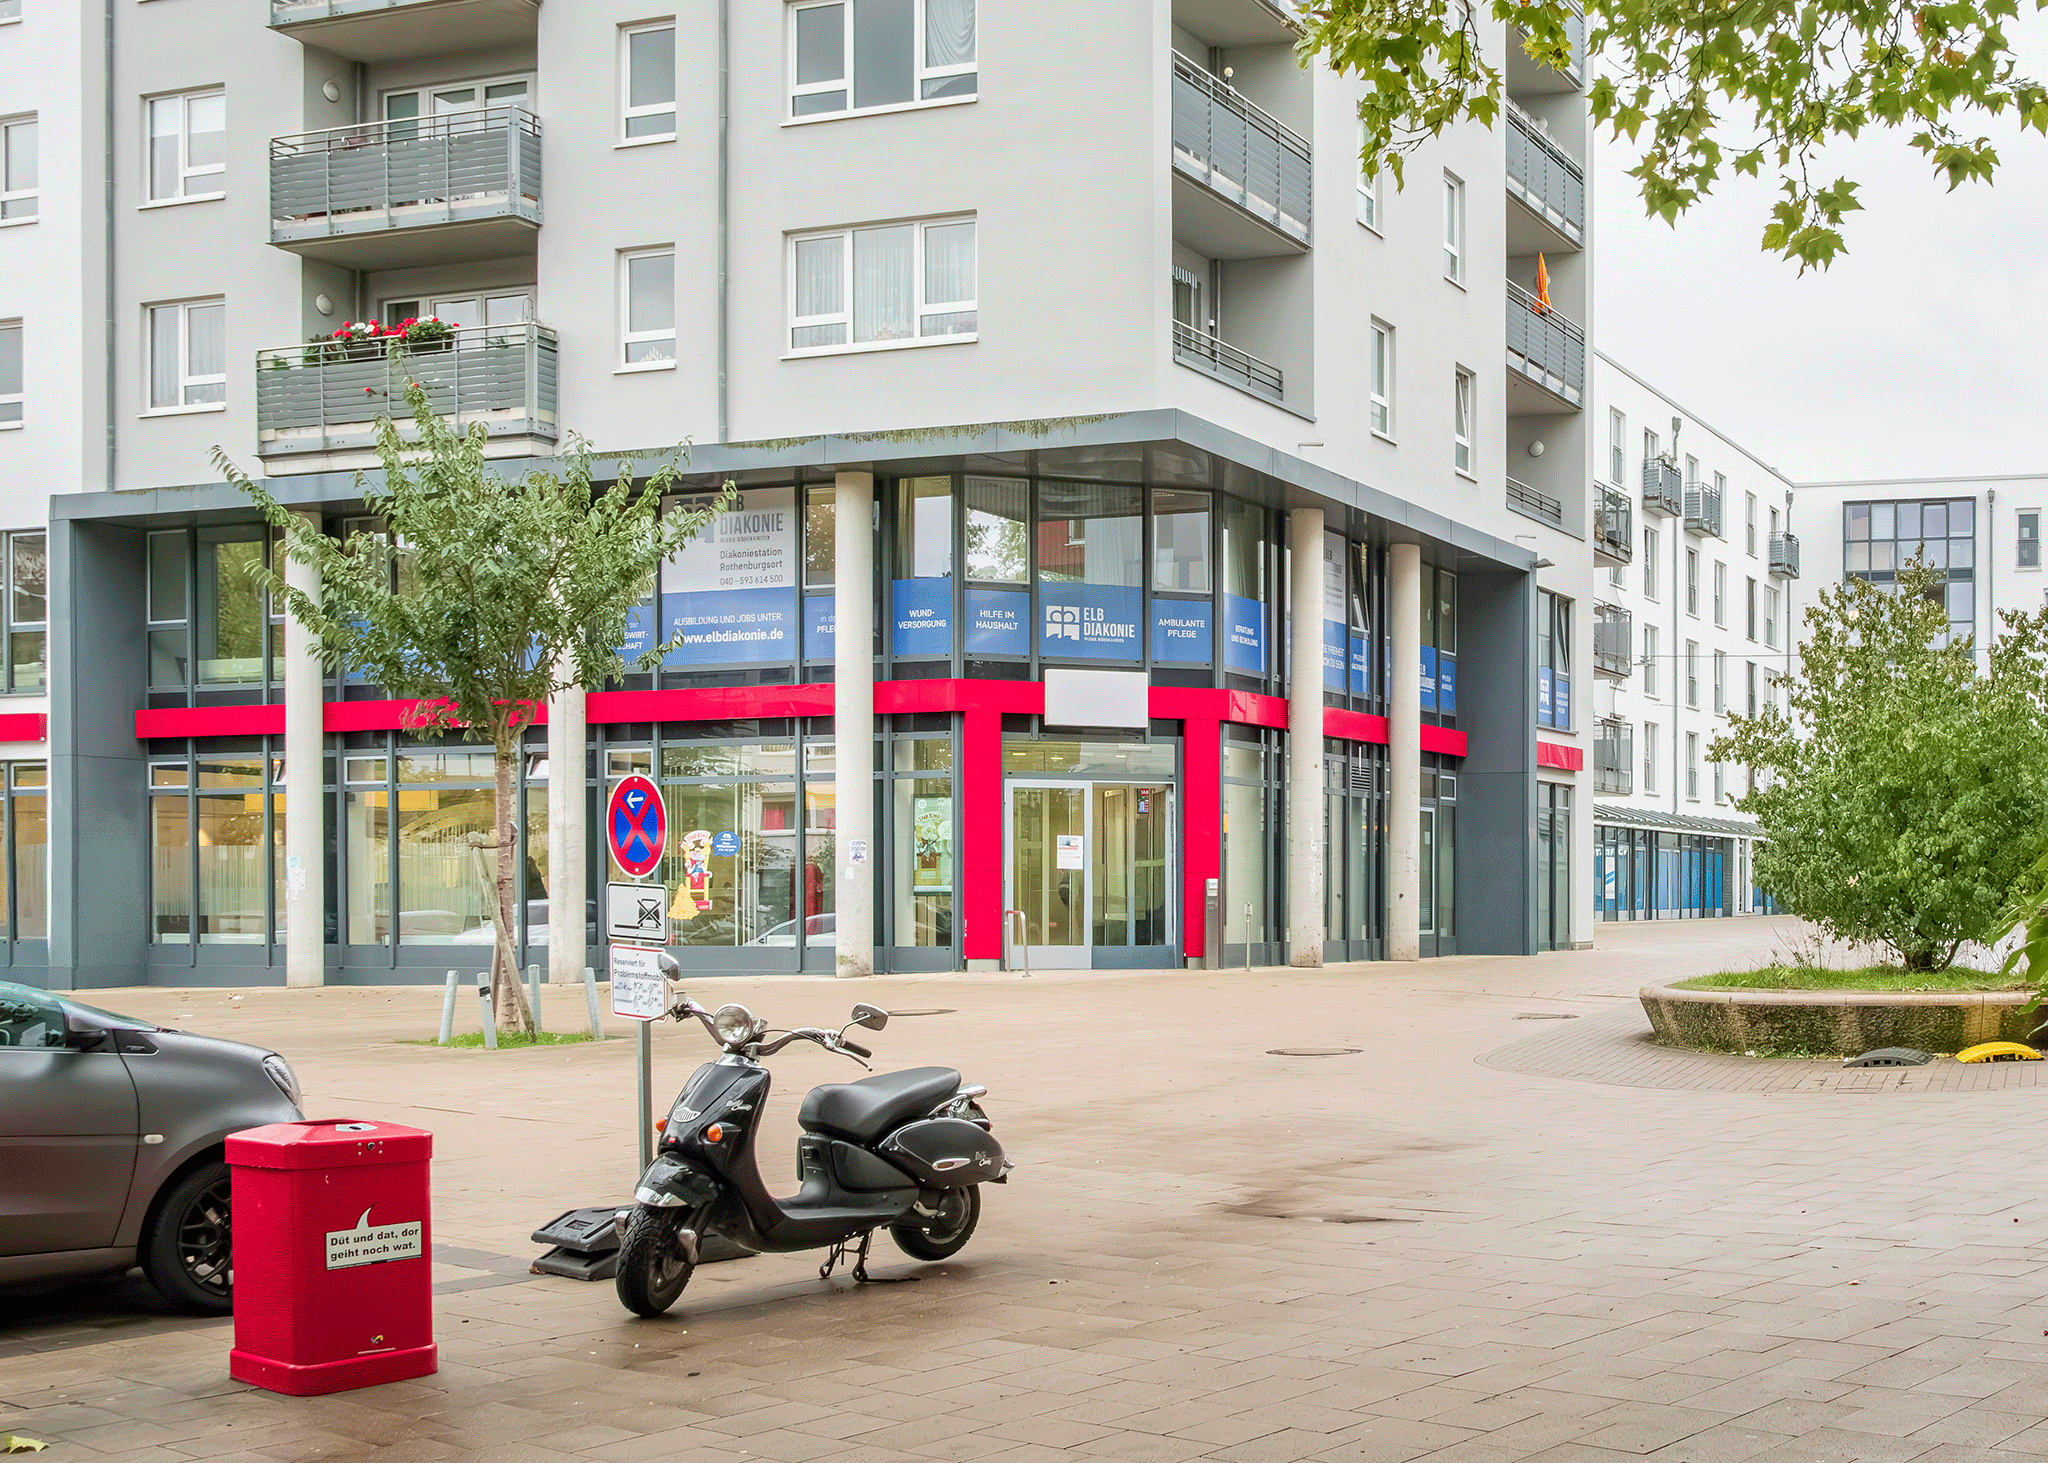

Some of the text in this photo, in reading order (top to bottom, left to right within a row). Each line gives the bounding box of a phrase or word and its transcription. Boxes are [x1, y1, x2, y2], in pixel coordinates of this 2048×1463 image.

[719, 512, 784, 535] DIAKONIE
[719, 547, 783, 560] Diakoniestation
[719, 560, 783, 571] Rothenburgsort
[719, 577, 734, 586] 040
[739, 576, 754, 585] 593
[754, 575, 768, 584] 614
[769, 574, 784, 583] 500
[673, 612, 783, 626] AUSBILDUNG UND JOBS UNTER:
[908, 608, 936, 618] WUND-
[979, 609, 1015, 619] HILFE IM
[1083, 606, 1105, 622] ELB
[898, 619, 947, 630] VERSORGUNG
[975, 620, 1019, 631] HAUSHALT
[1158, 618, 1205, 628] AMBULANTE
[816, 625, 836, 634] PFLE
[1083, 622, 1136, 638] DIAKONIE
[1167, 629, 1197, 639] PFLEGE
[674, 628, 784, 644] www.elbdiakonie.de
[330, 1228, 420, 1247] Düt und dat, dor
[330, 1241, 416, 1262] geiht noch wat.
